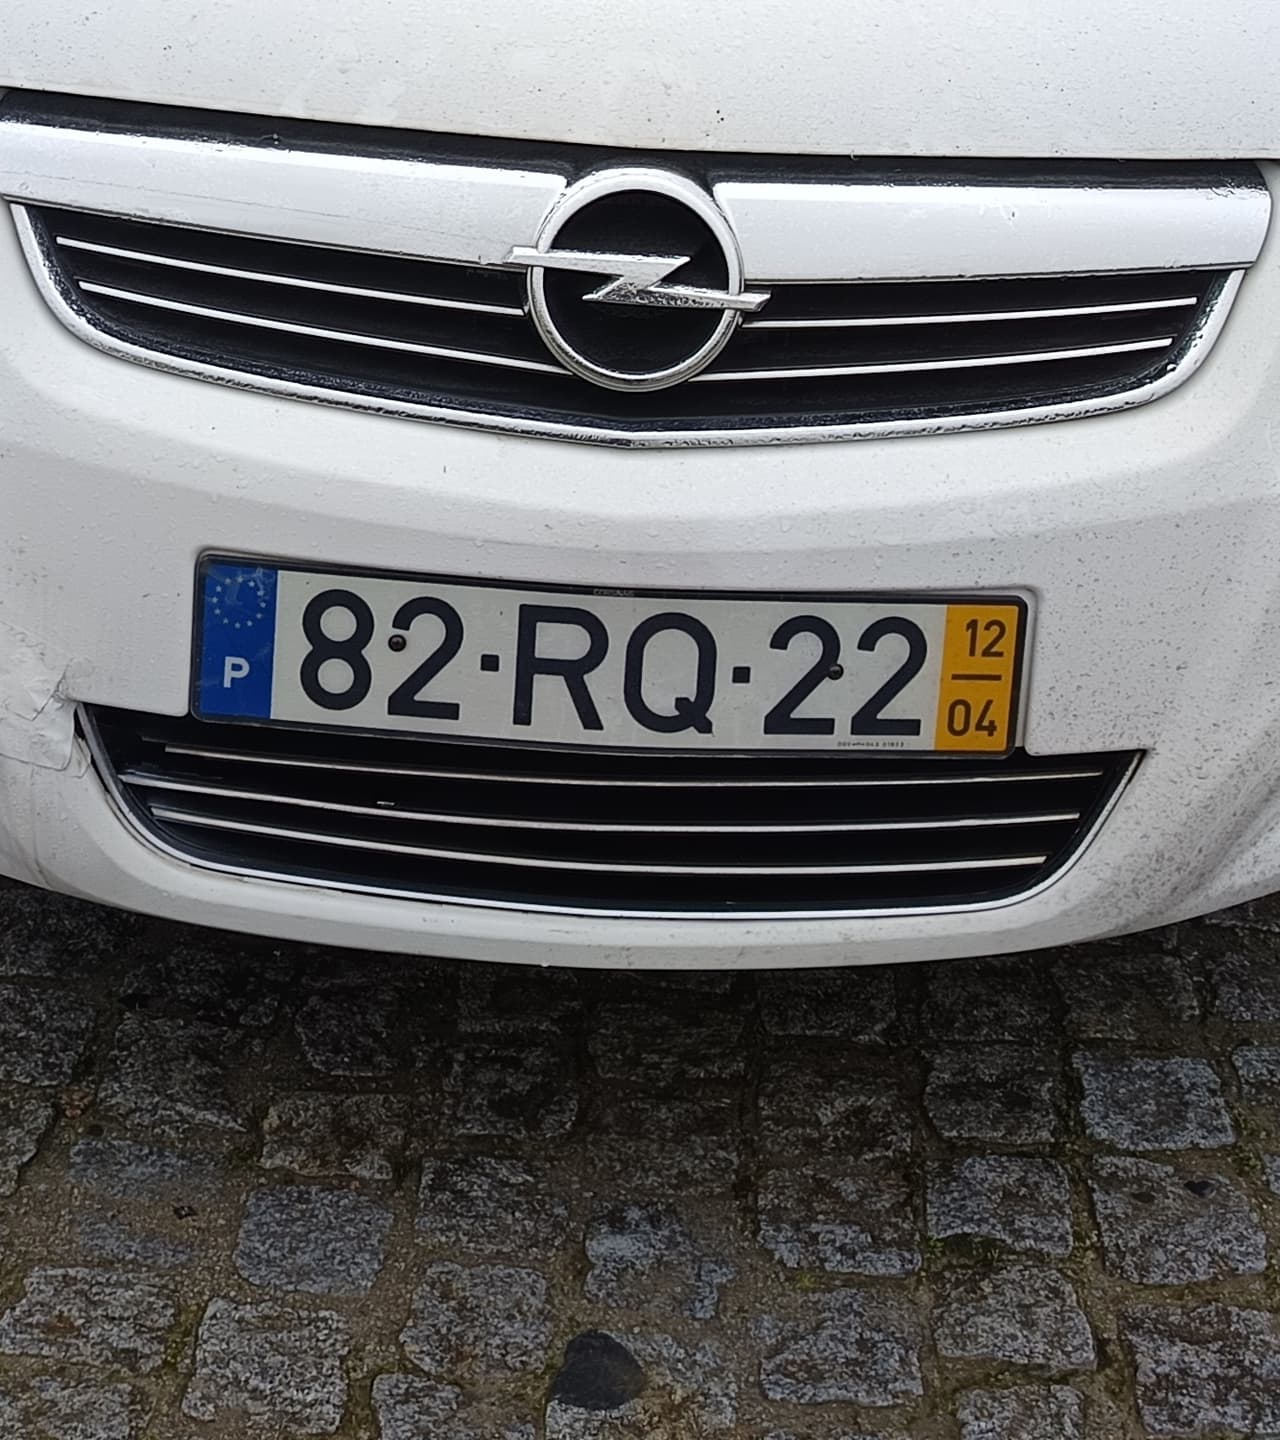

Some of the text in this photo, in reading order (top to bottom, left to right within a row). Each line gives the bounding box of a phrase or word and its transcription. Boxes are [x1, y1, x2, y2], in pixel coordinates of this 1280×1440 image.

[965, 618, 1007, 658] 12
[223, 656, 250, 689] P
[947, 698, 998, 737] 04
